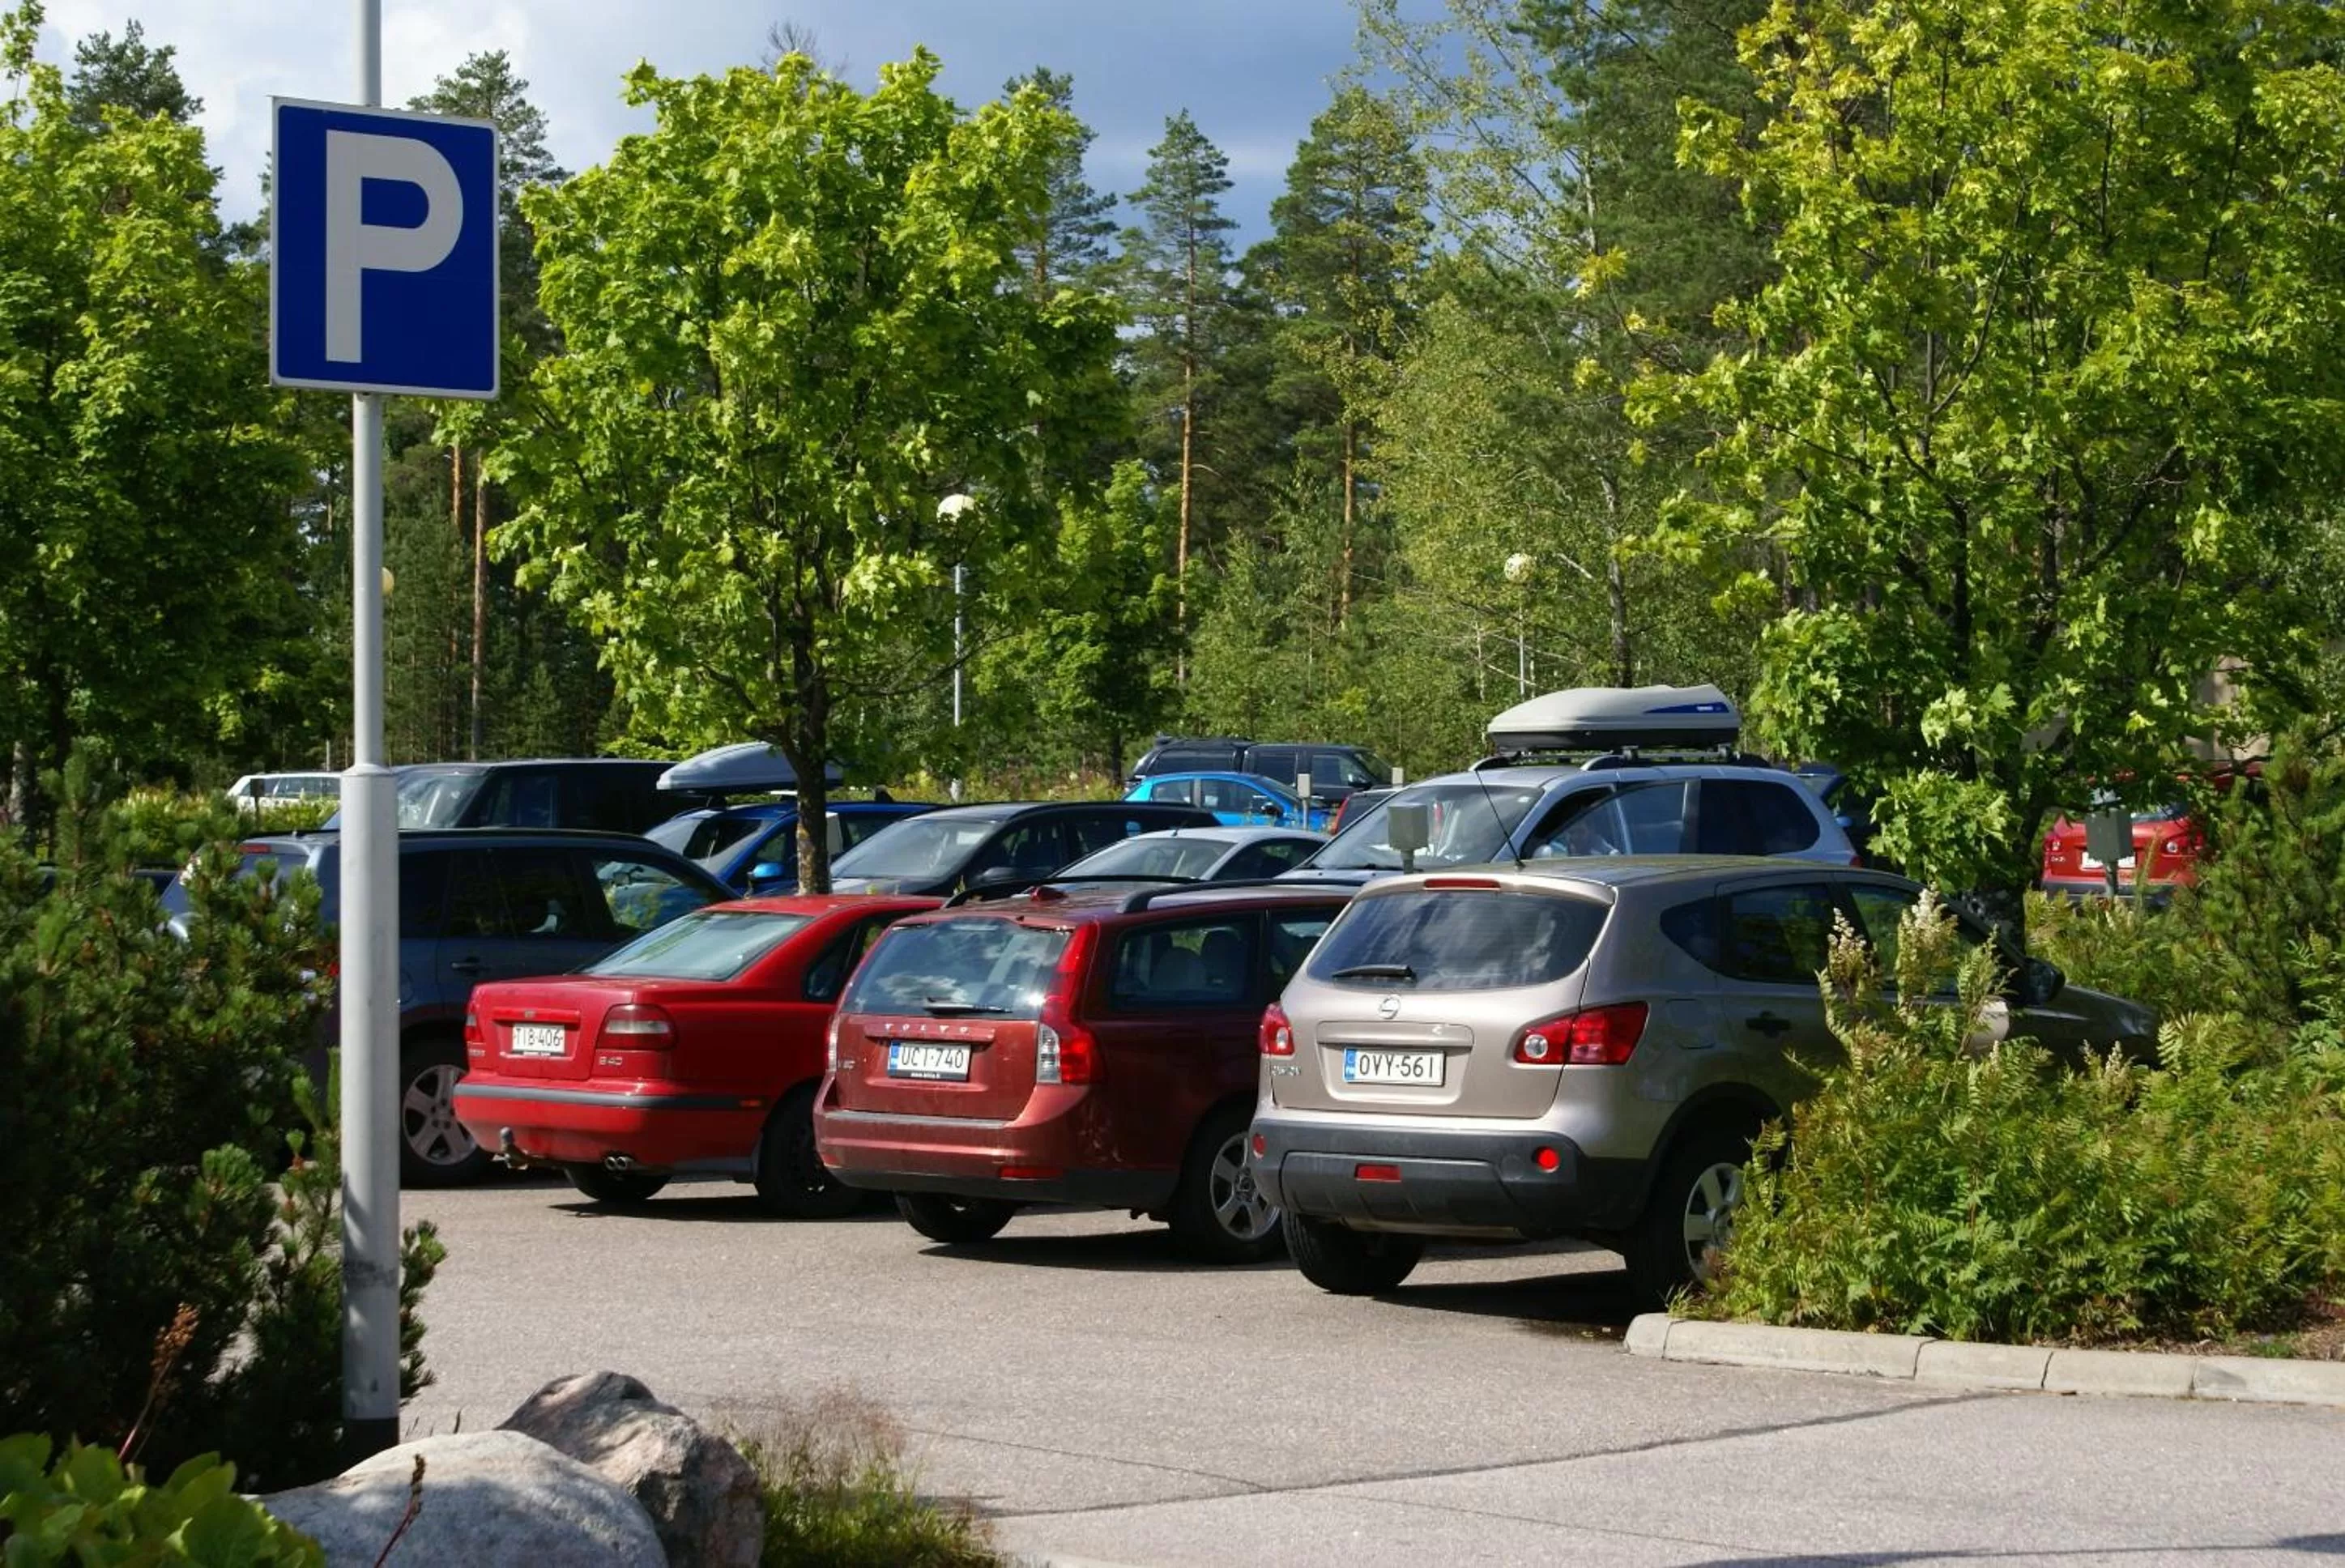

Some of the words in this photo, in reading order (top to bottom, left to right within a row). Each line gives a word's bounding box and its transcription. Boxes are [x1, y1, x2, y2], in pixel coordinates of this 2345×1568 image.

[326, 130, 463, 363] P
[885, 1023, 969, 1033] VOLVO
[902, 1046, 964, 1068] UCT-740
[1359, 1055, 1434, 1078] OVY-561
